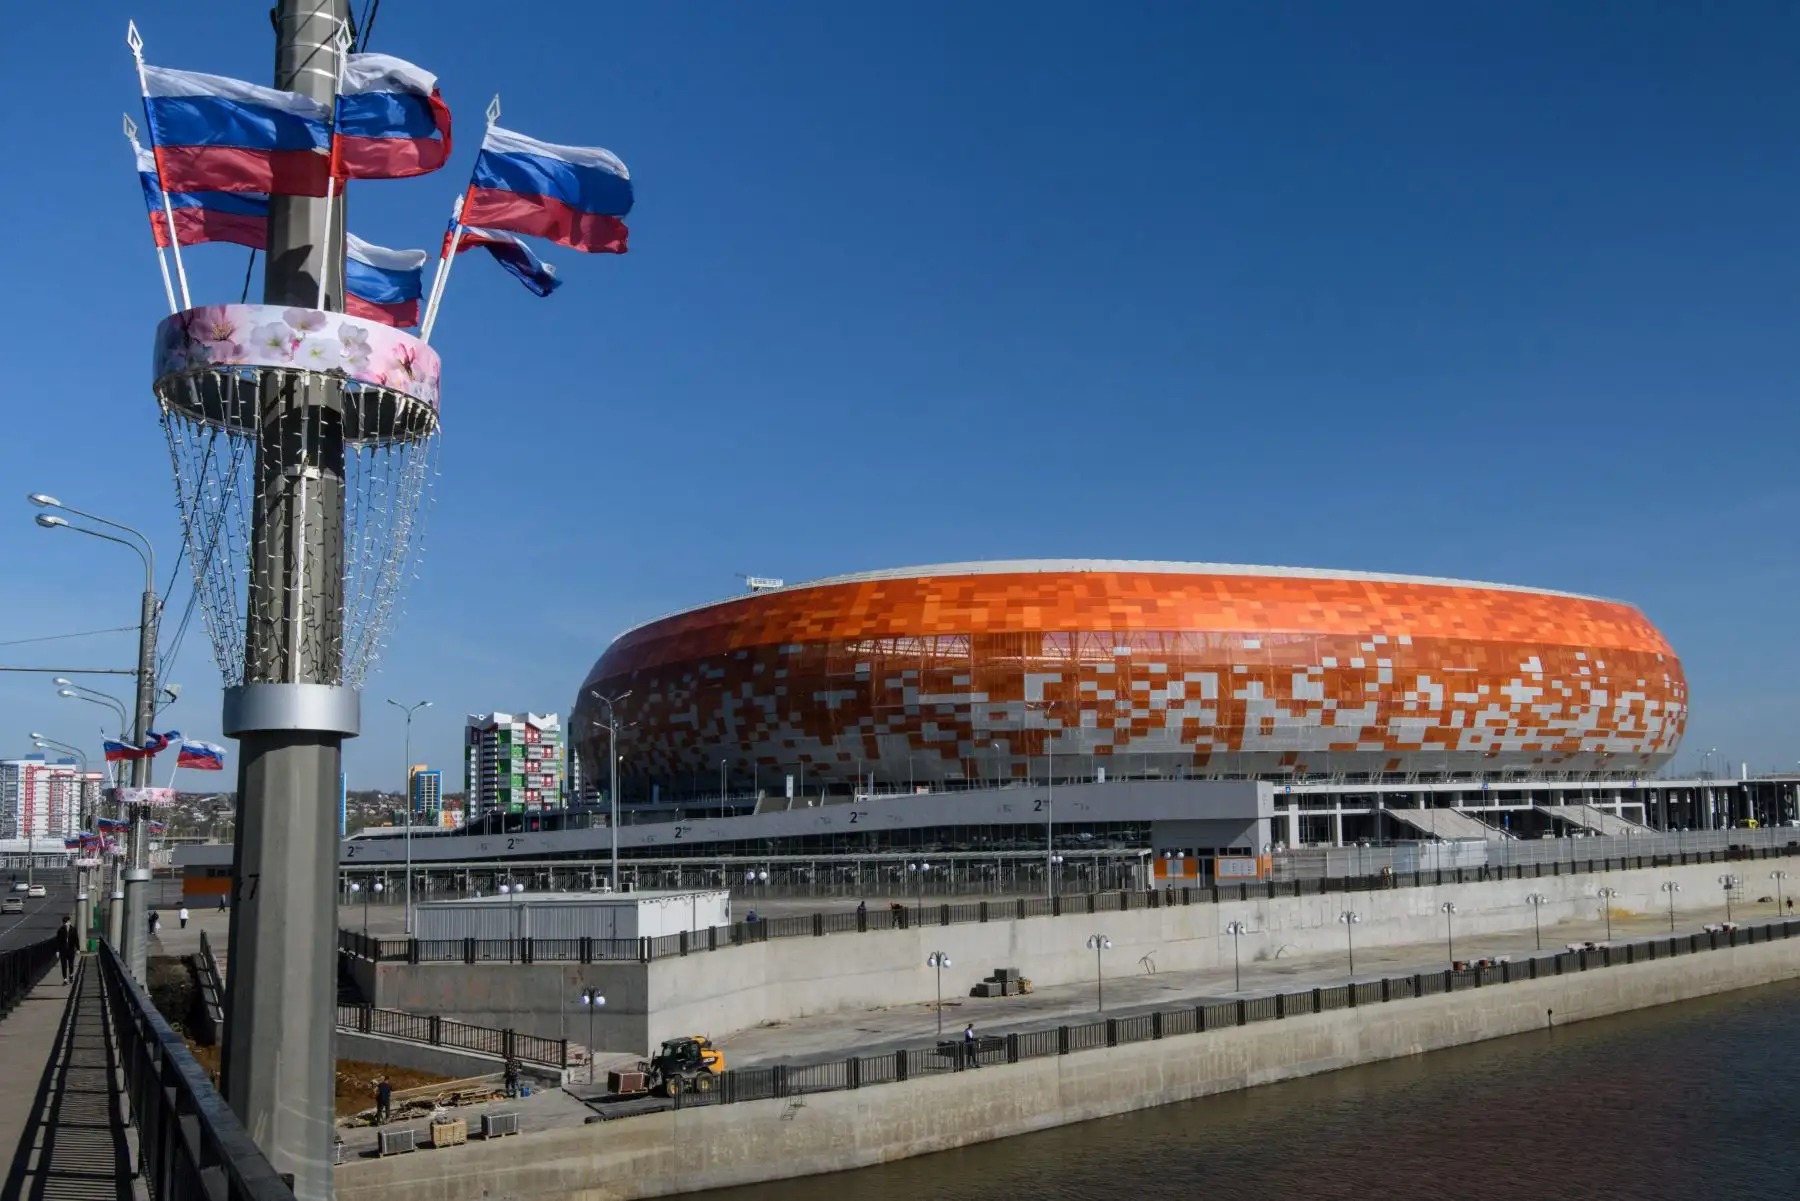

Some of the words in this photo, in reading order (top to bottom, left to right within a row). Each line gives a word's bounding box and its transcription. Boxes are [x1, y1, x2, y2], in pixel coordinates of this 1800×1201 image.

[1034, 799, 1042, 811] 2
[850, 811, 858, 823] 2
[675, 827, 682, 838] 2
[507, 838, 515, 849] 2
[347, 846, 355, 857] 2
